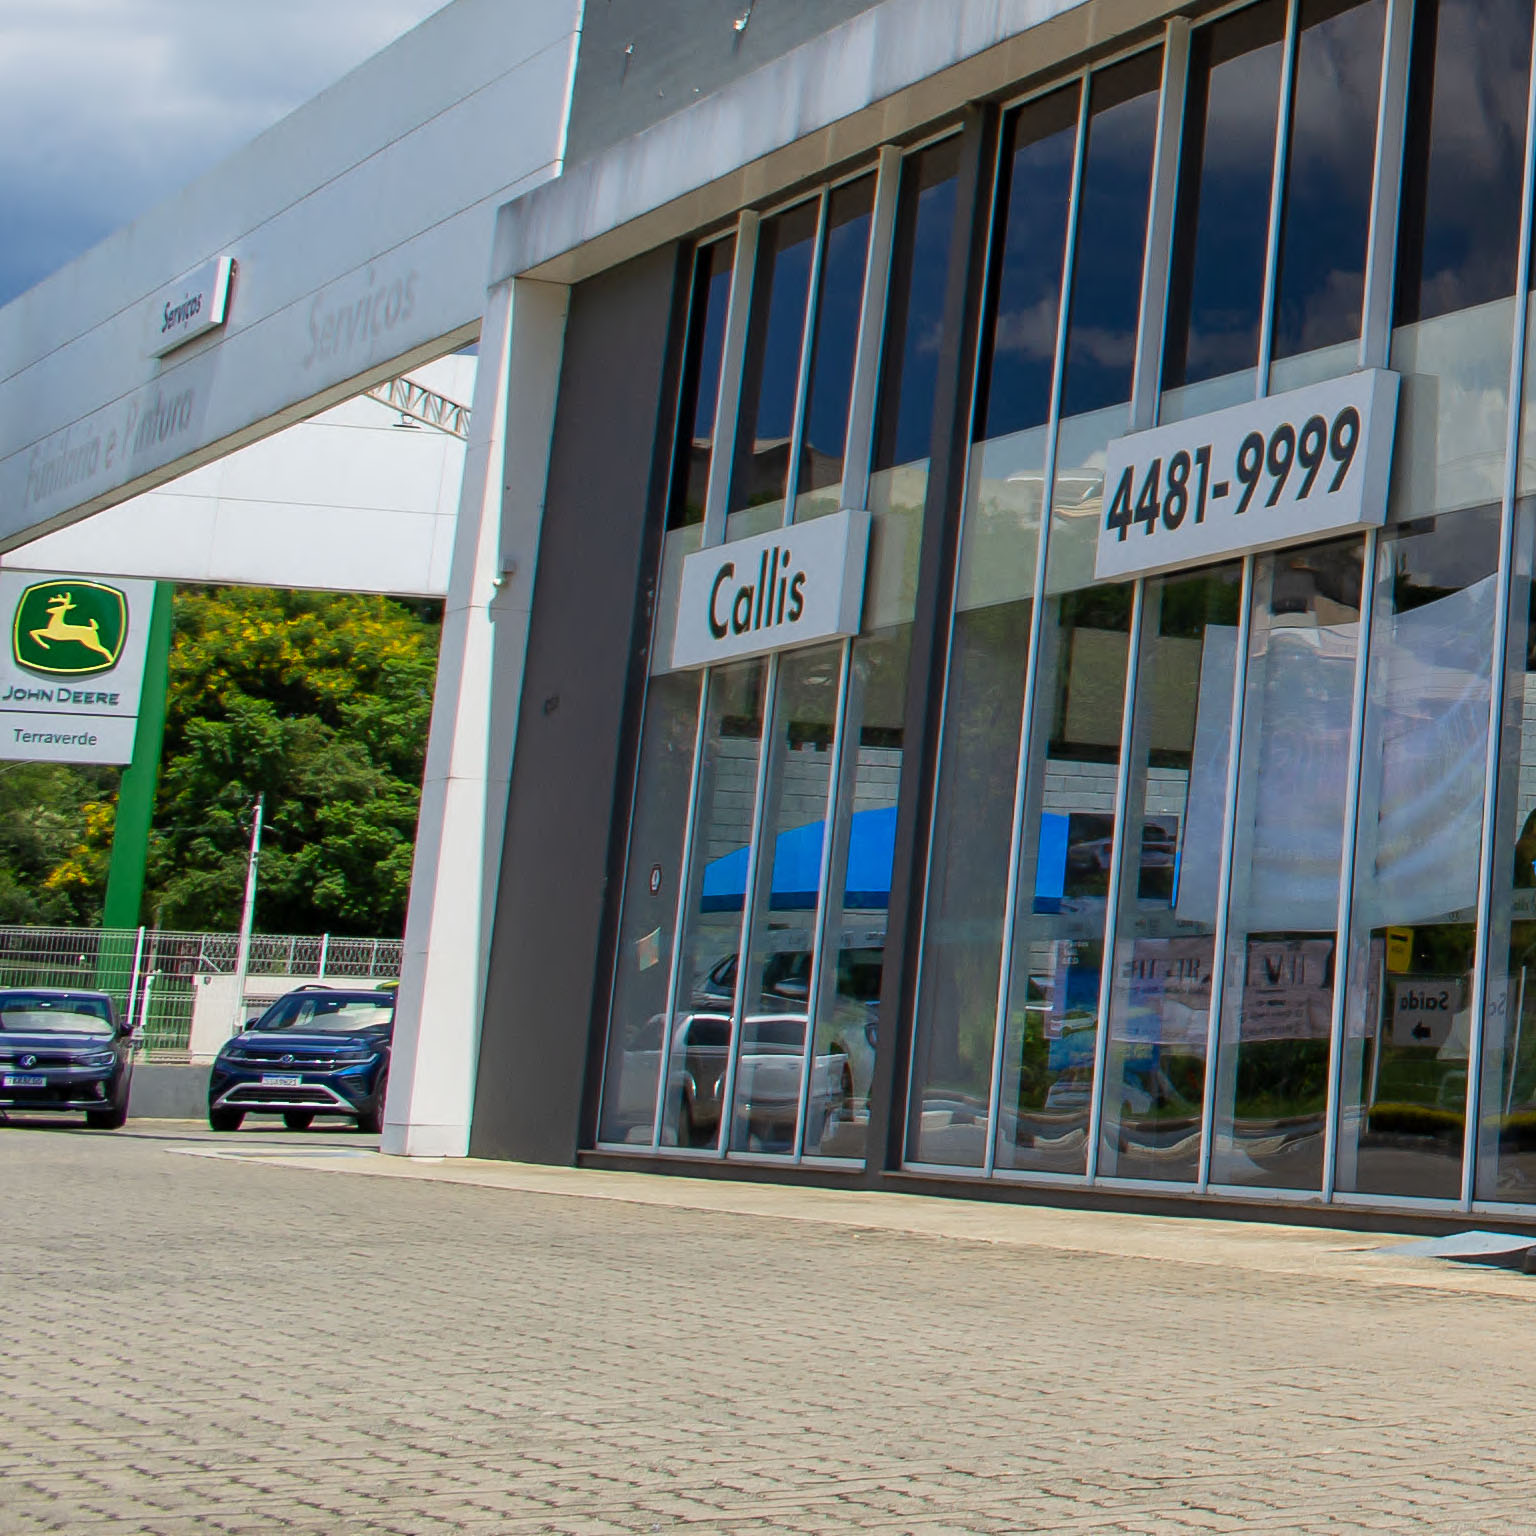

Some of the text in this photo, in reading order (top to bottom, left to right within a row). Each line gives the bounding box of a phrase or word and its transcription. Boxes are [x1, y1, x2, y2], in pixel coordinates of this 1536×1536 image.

[161, 293, 203, 334] Serviços
[1106, 405, 1361, 542] 4481-9999
[708, 546, 806, 640] Callis
[2, 685, 121, 706] JOHN DEERE
[13, 728, 98, 746] Terraverde
